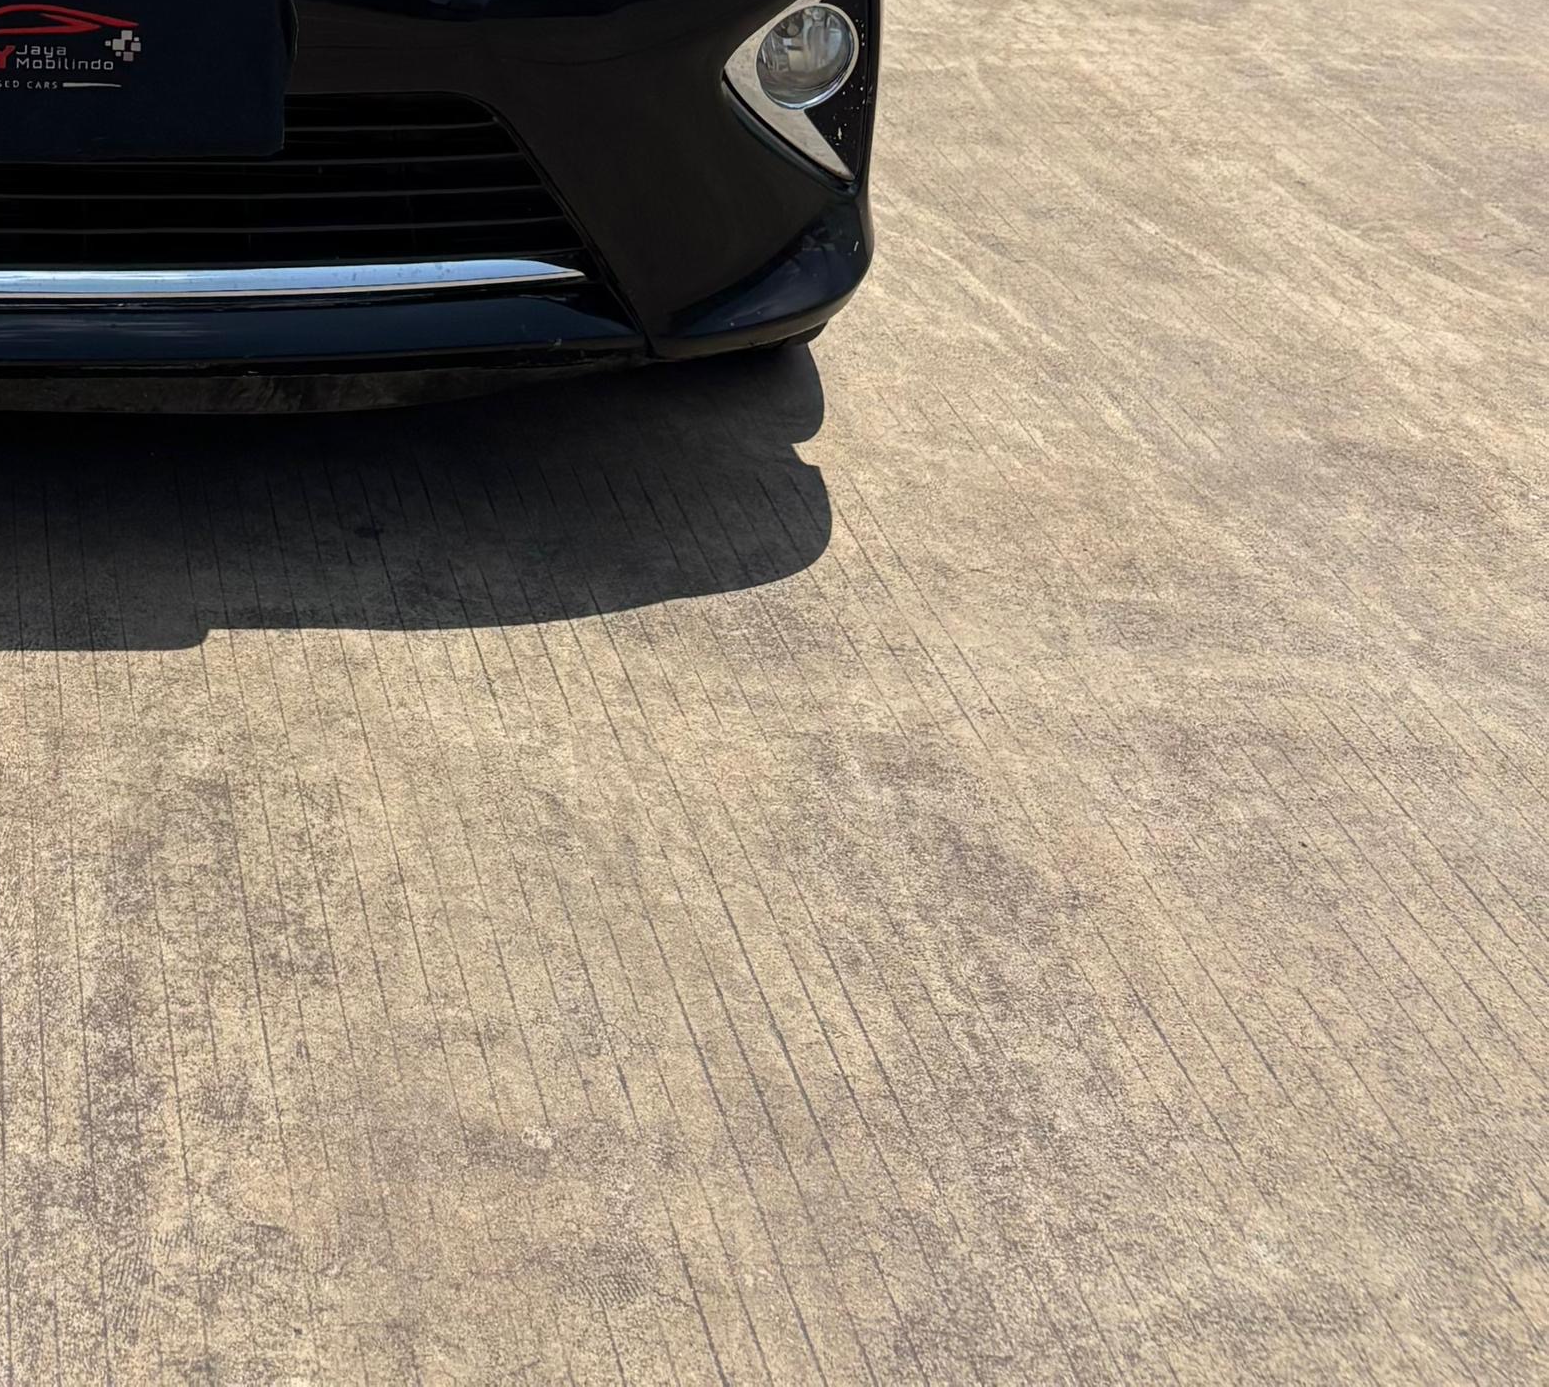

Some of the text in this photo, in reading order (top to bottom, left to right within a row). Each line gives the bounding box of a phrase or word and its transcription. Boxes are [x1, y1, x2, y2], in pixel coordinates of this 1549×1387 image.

[16, 45, 67, 60] Jaya
[16, 56, 114, 71] Mobilindo
[26, 80, 58, 90] CARS
